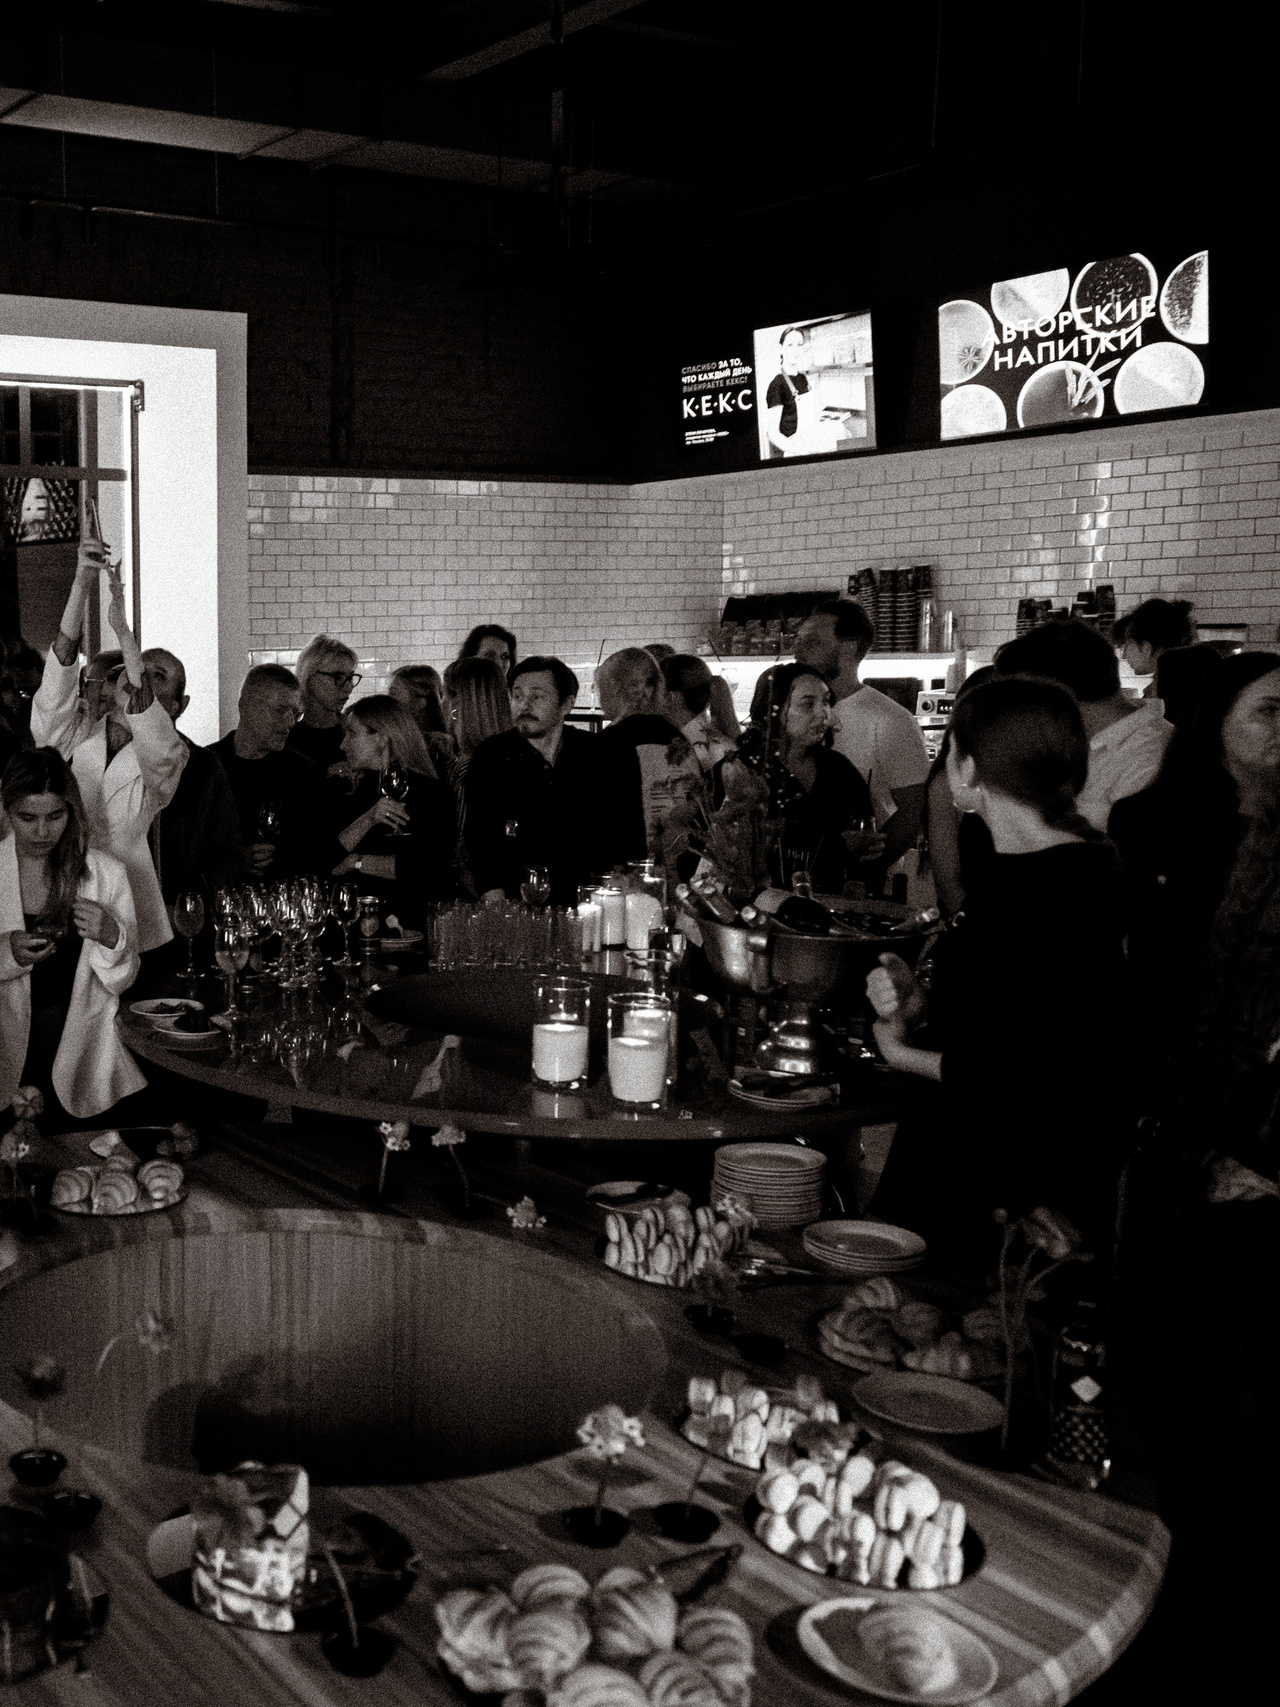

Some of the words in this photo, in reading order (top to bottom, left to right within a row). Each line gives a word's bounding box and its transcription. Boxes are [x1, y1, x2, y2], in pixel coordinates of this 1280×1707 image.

[982, 295, 1156, 347] АВТОРСКИЕ
[993, 325, 1142, 371] НАПИТКИ
[681, 362, 717, 375] СПАСИБО
[718, 360, 729, 369] ЗА
[681, 374, 697, 384] ЧТО
[698, 368, 731, 382] КАЖДЫЙ
[732, 365, 753, 377] ДЕНЬ
